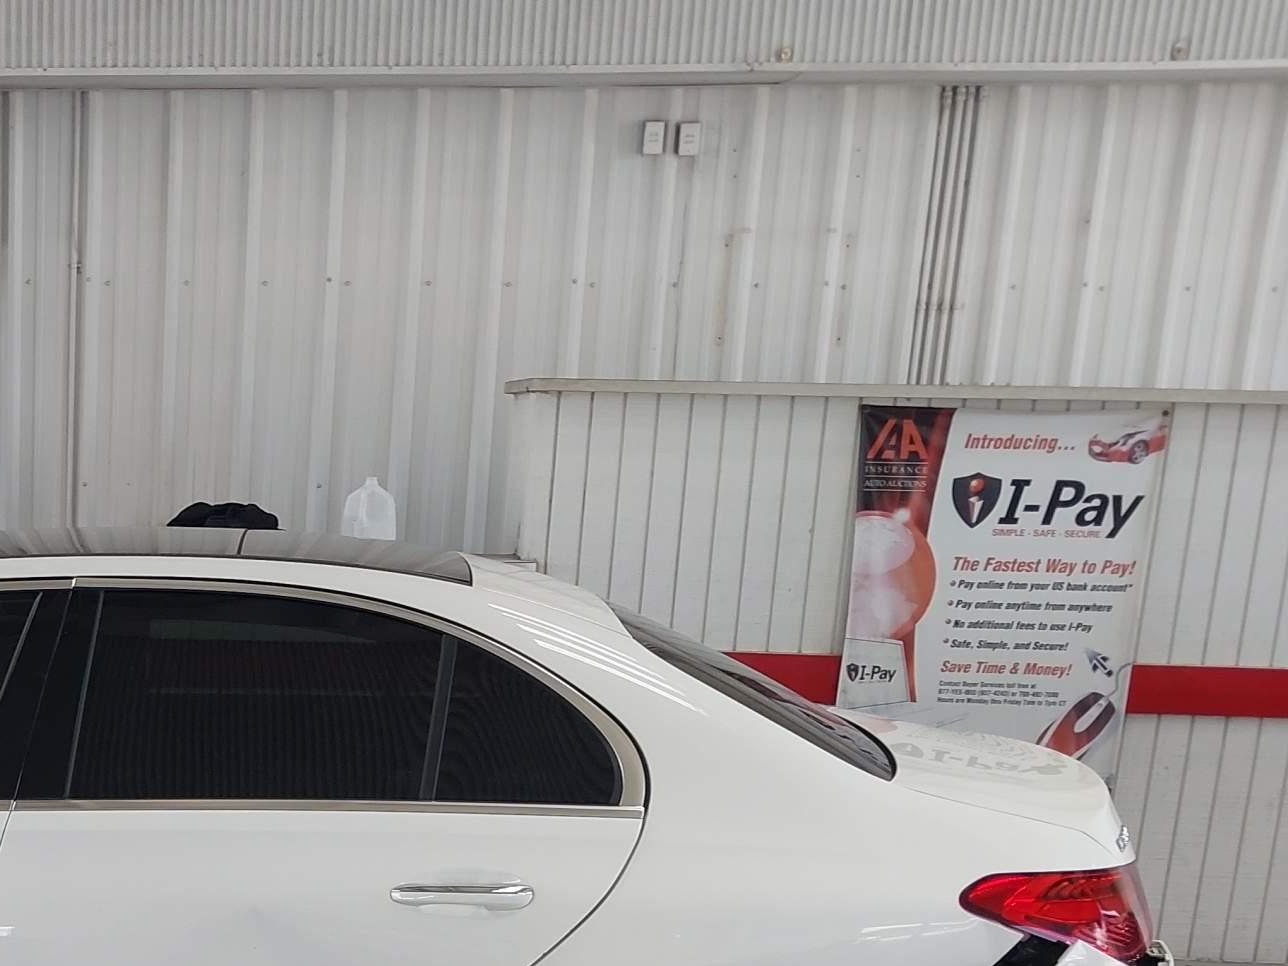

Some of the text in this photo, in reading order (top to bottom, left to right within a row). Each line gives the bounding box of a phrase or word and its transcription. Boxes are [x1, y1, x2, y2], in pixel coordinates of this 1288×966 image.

[964, 434, 1075, 453] Introducing...
[864, 465, 928, 473] INSURANCE
[998, 479, 1145, 538] I-Pay
[992, 529, 1025, 537] SIMPLE
[1033, 529, 1056, 538] SAFE
[1064, 530, 1101, 538] SECURE
[953, 556, 1137, 578] The Fastest Way to Pay!
[958, 580, 976, 591] Pay
[977, 581, 1005, 590] online
[1007, 581, 1028, 590] from
[1029, 584, 1050, 592] your
[1066, 582, 1089, 592] bank
[955, 600, 1113, 613] Pay online anytime from anywhere
[952, 619, 965, 628] No
[967, 620, 1014, 629] additional
[1016, 621, 1035, 630] fees
[1038, 622, 1048, 631] to
[1013, 641, 1031, 650] and
[1032, 641, 1069, 651] Secure!
[859, 665, 896, 682] I-Pay
[940, 660, 1073, 678] Save Time & Money!
